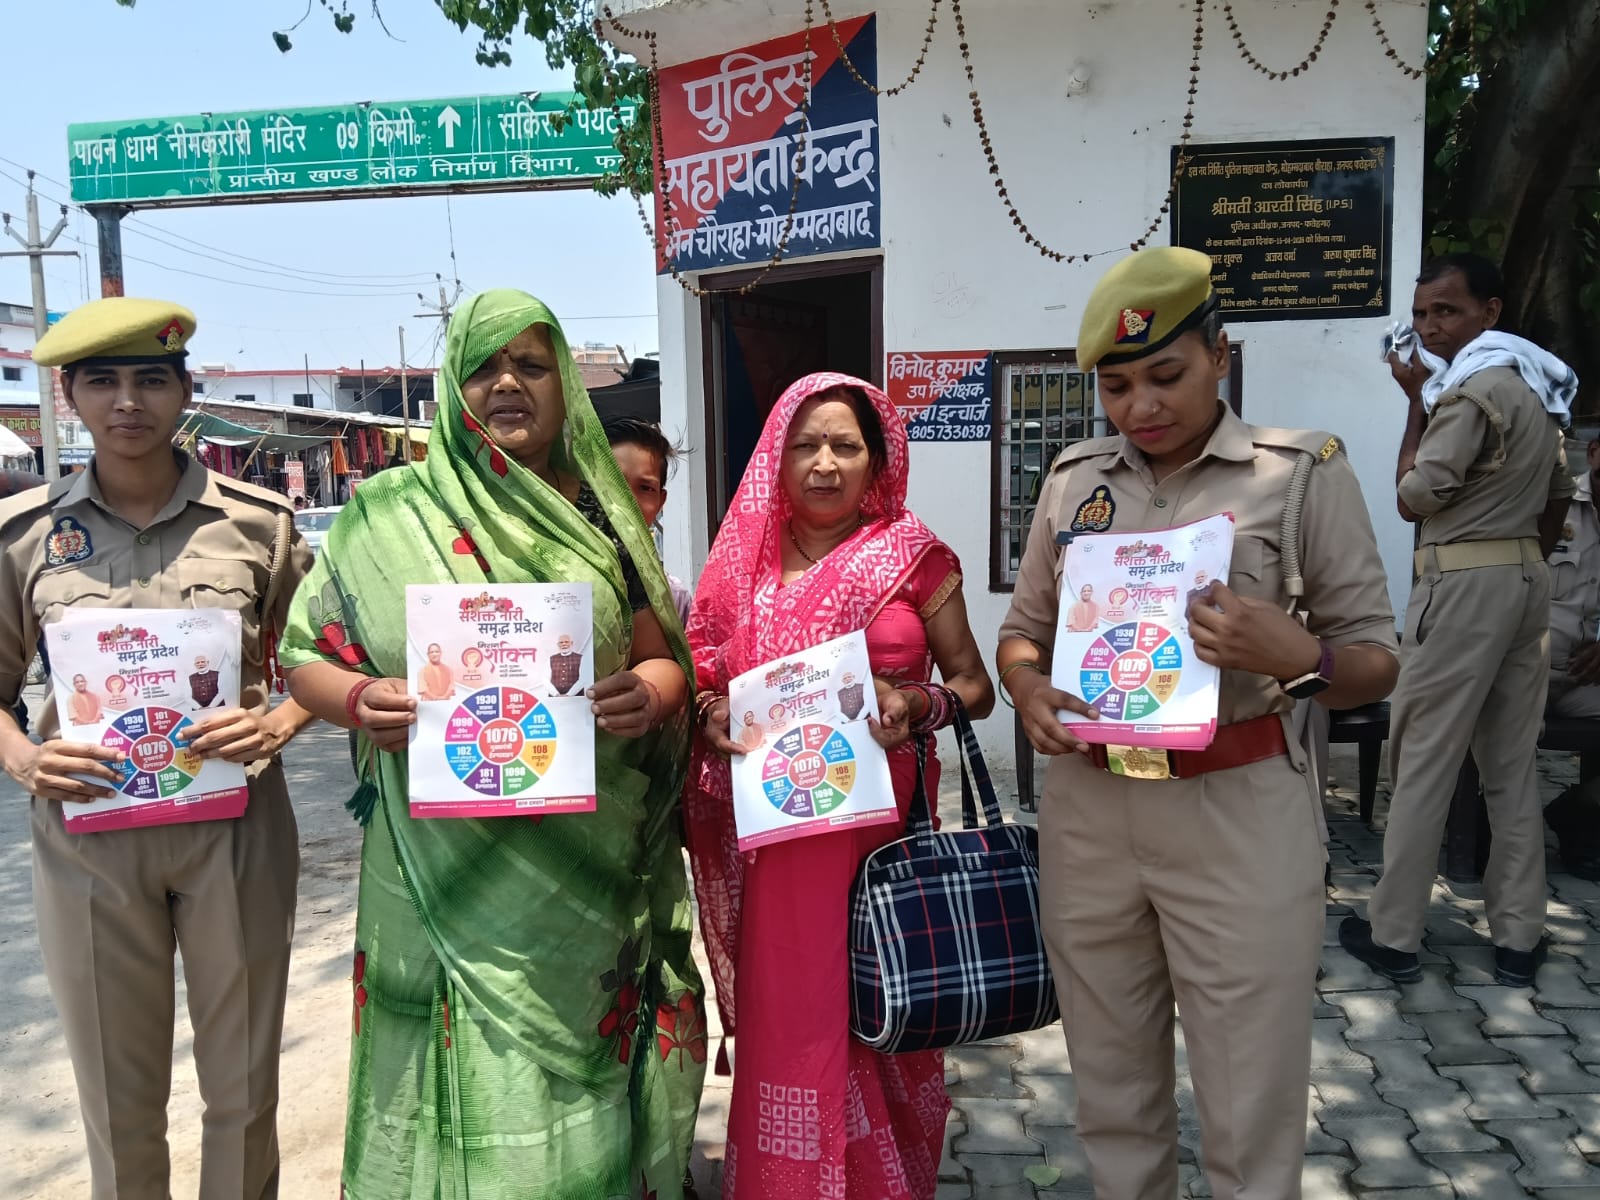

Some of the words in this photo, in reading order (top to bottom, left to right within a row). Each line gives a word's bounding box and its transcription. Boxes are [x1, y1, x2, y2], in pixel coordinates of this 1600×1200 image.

[682, 51, 818, 143] पुलिस
[74, 138, 116, 165] पावन
[127, 135, 158, 162] धाम
[261, 116, 307, 153] मंदिर
[337, 121, 361, 150] 09
[229, 169, 297, 188] प्रान्तीय
[309, 169, 359, 185] खण्ड
[372, 160, 418, 180] लोक
[431, 155, 497, 177] निर्माण
[661, 138, 790, 214] सहायता
[1225, 161, 1241, 178] पुलिस
[1242, 164, 1265, 176] सहायता
[1274, 178, 1308, 189] लोकार्पण
[1211, 196, 1252, 216] श्रीमती
[1254, 195, 1294, 214] आरती
[1296, 194, 1325, 213] सिंह
[1231, 220, 1250, 233] पुलिस
[1223, 253, 1243, 267] शुक्ल
[1264, 252, 1283, 262] अजय
[1283, 248, 1296, 261] वर्मा
[1343, 249, 1363, 263] कुमार
[1363, 244, 1377, 260] सिंह
[889, 354, 936, 380] विनोद
[936, 358, 987, 384] कुमार
[907, 385, 927, 399] उप
[929, 379, 984, 401] निरीक्षक
[1128, 565, 1158, 580] समृद्ध
[1160, 560, 1185, 574] प्रदेश
[458, 610, 498, 622] सशक्त
[500, 606, 523, 622] नारी
[477, 622, 510, 639] समृद्ध
[513, 618, 543, 635] प्रदेश
[117, 650, 147, 665] समृद्ध
[151, 645, 179, 659] प्रदेश
[1117, 657, 1150, 672] 1076
[484, 727, 518, 743] 1076
[135, 740, 169, 757] 1076
[792, 755, 822, 774] 1076
